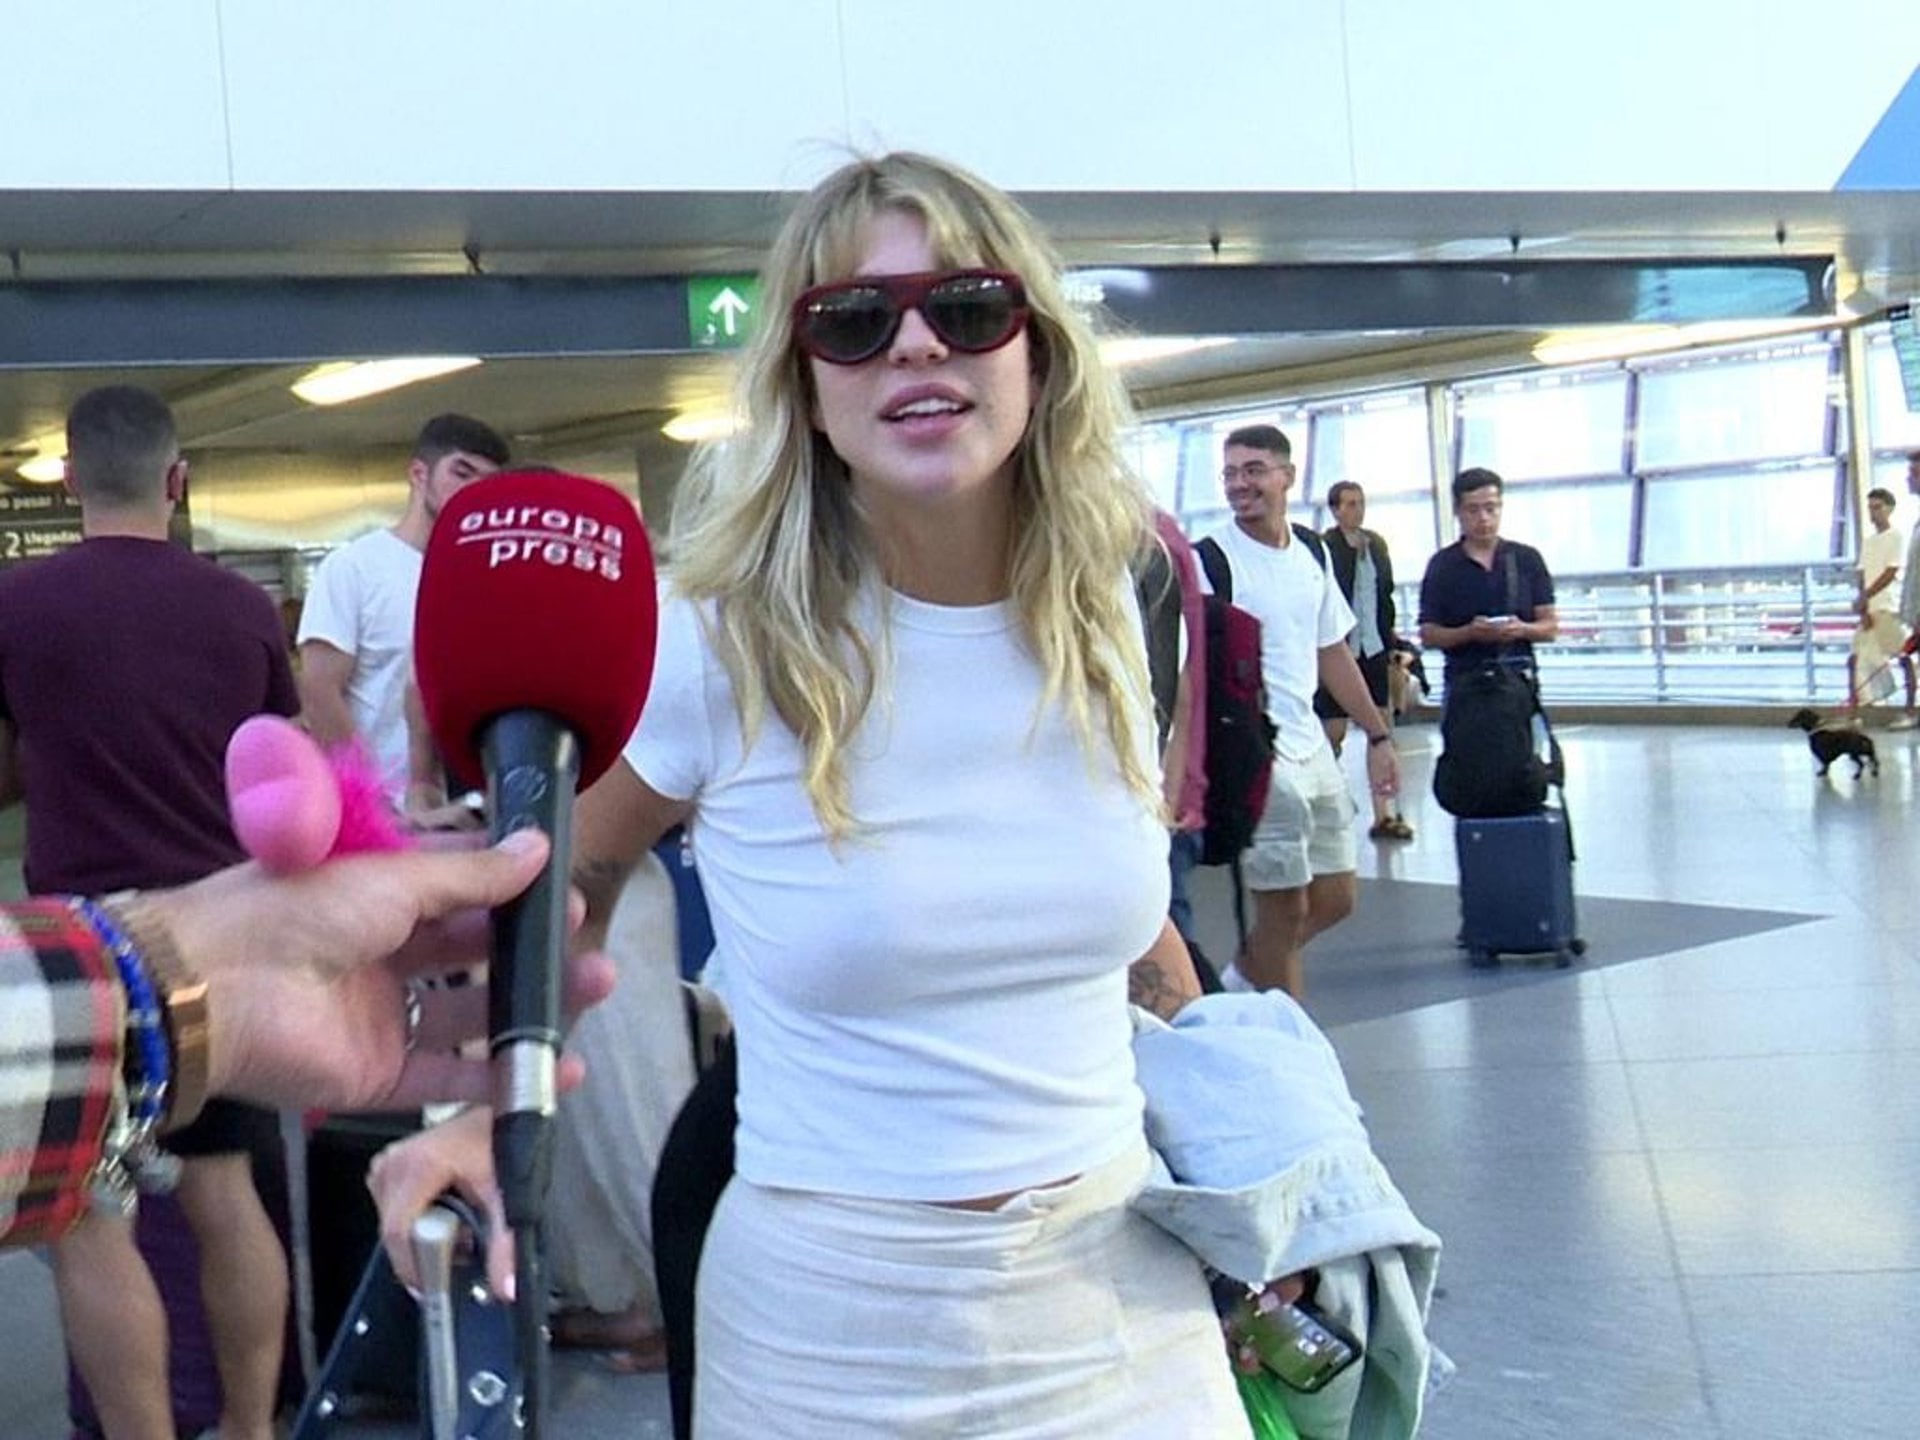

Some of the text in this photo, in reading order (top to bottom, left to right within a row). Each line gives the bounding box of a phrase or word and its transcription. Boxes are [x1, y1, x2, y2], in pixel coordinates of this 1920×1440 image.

[5, 532, 21, 558] 2
[460, 507, 622, 548] europa
[490, 538, 621, 581] press
